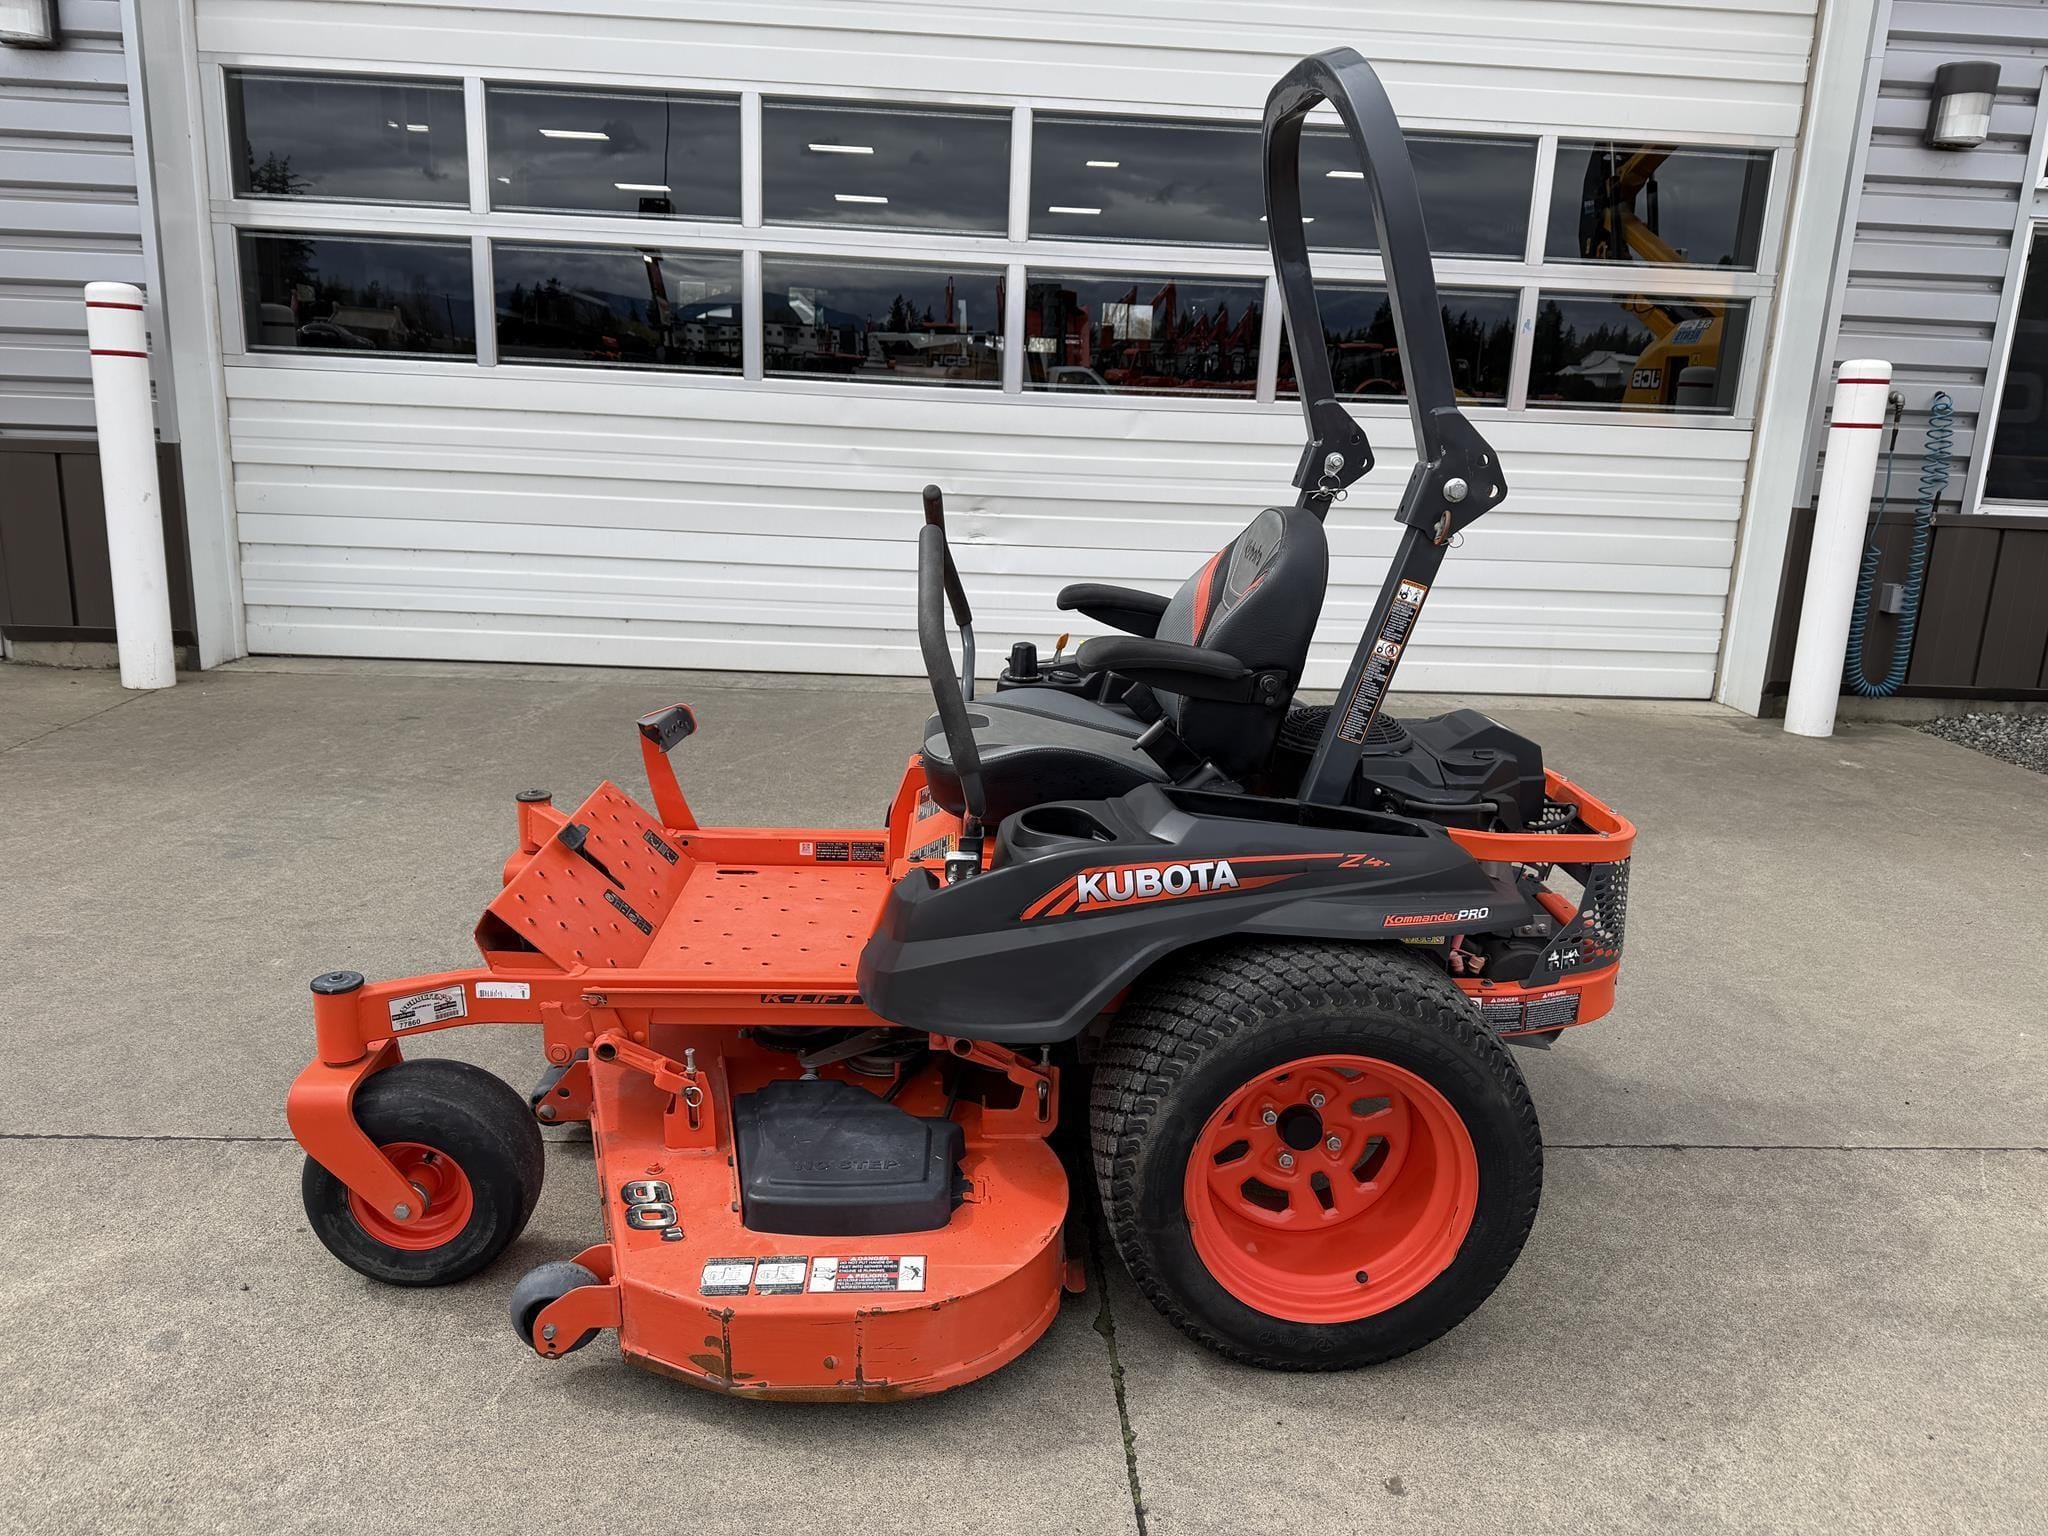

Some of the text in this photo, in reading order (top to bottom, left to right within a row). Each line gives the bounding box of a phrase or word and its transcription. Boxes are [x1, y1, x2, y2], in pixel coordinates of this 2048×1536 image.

[1077, 860, 1239, 903] KUBOTA
[1384, 907, 1489, 927] KommanderPRO
[399, 1019, 421, 1029] 77860
[837, 1159, 899, 1171] STEP
